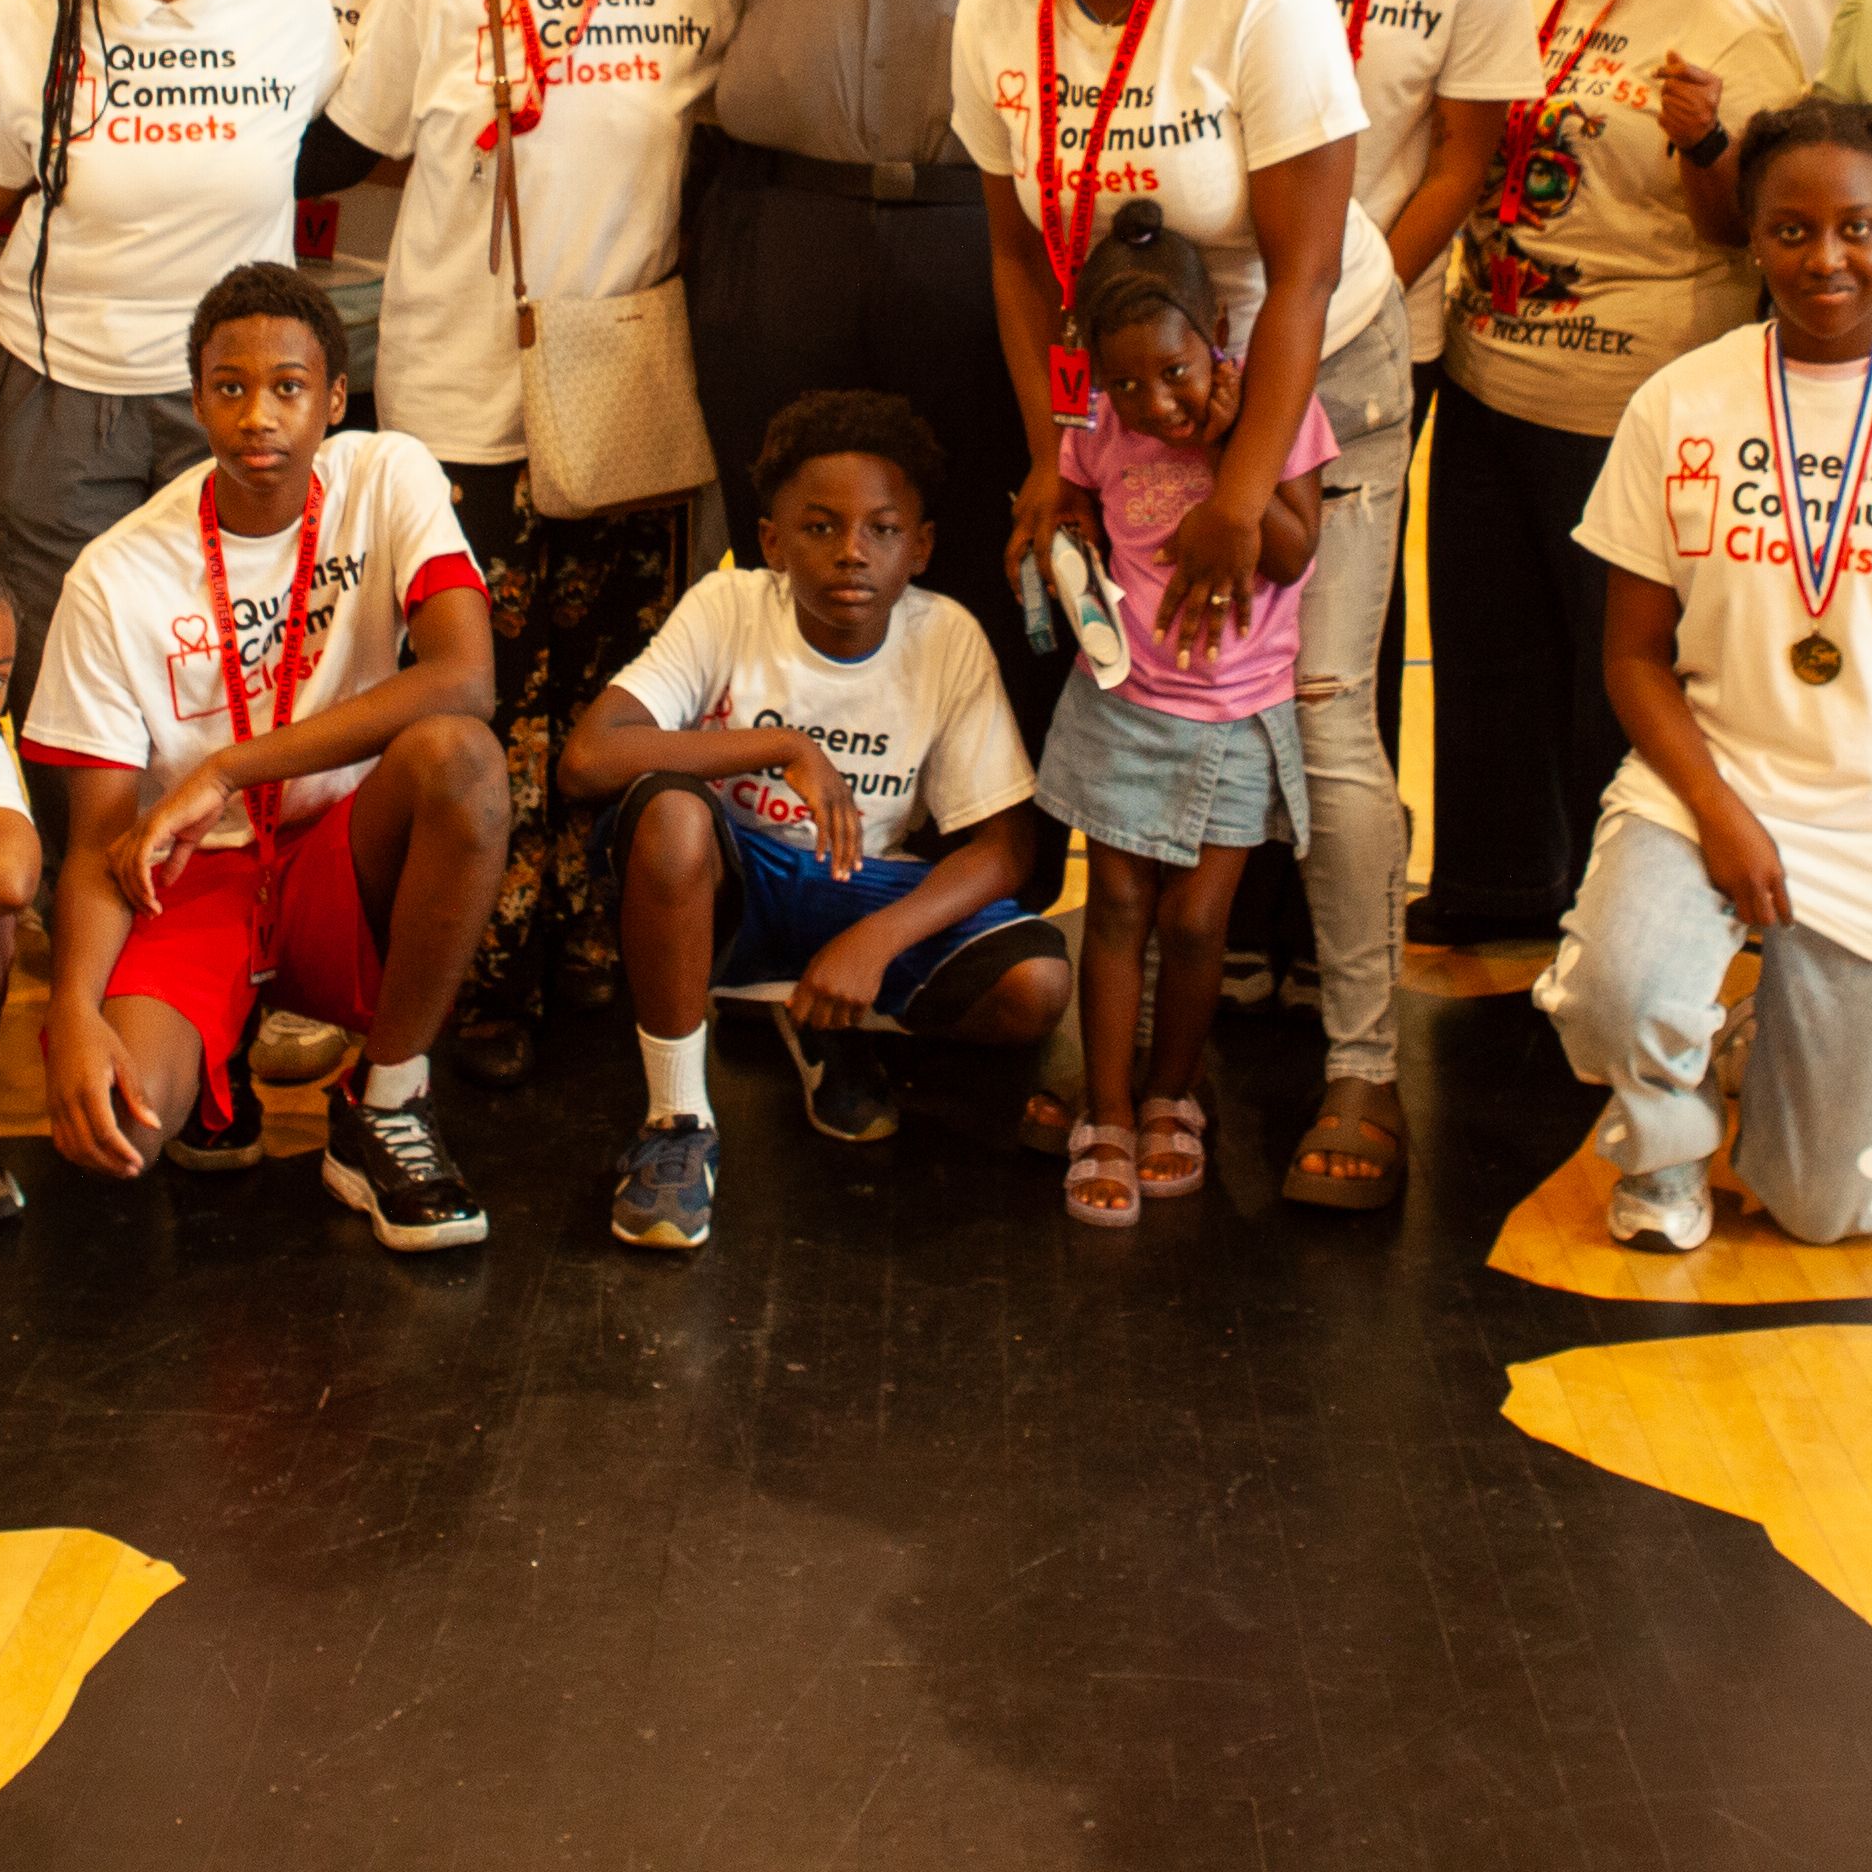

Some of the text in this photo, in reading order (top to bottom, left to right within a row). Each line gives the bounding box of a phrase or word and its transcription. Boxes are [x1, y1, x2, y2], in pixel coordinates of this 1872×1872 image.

[540, 15, 711, 55] Community
[108, 44, 238, 72] Queens
[543, 53, 662, 86] Closets
[108, 77, 296, 113] Community
[1612, 79, 1650, 110] 55
[106, 114, 238, 145] Closets
[1041, 98, 1056, 183] VOLUNTEER
[1555, 324, 1635, 355] WEEK
[293, 531, 317, 614] VOLUNTEER
[208, 551, 233, 635] VOLUNTEER
[277, 633, 300, 716] VOLUNTEER
[226, 655, 249, 738] VOLUNTEER
